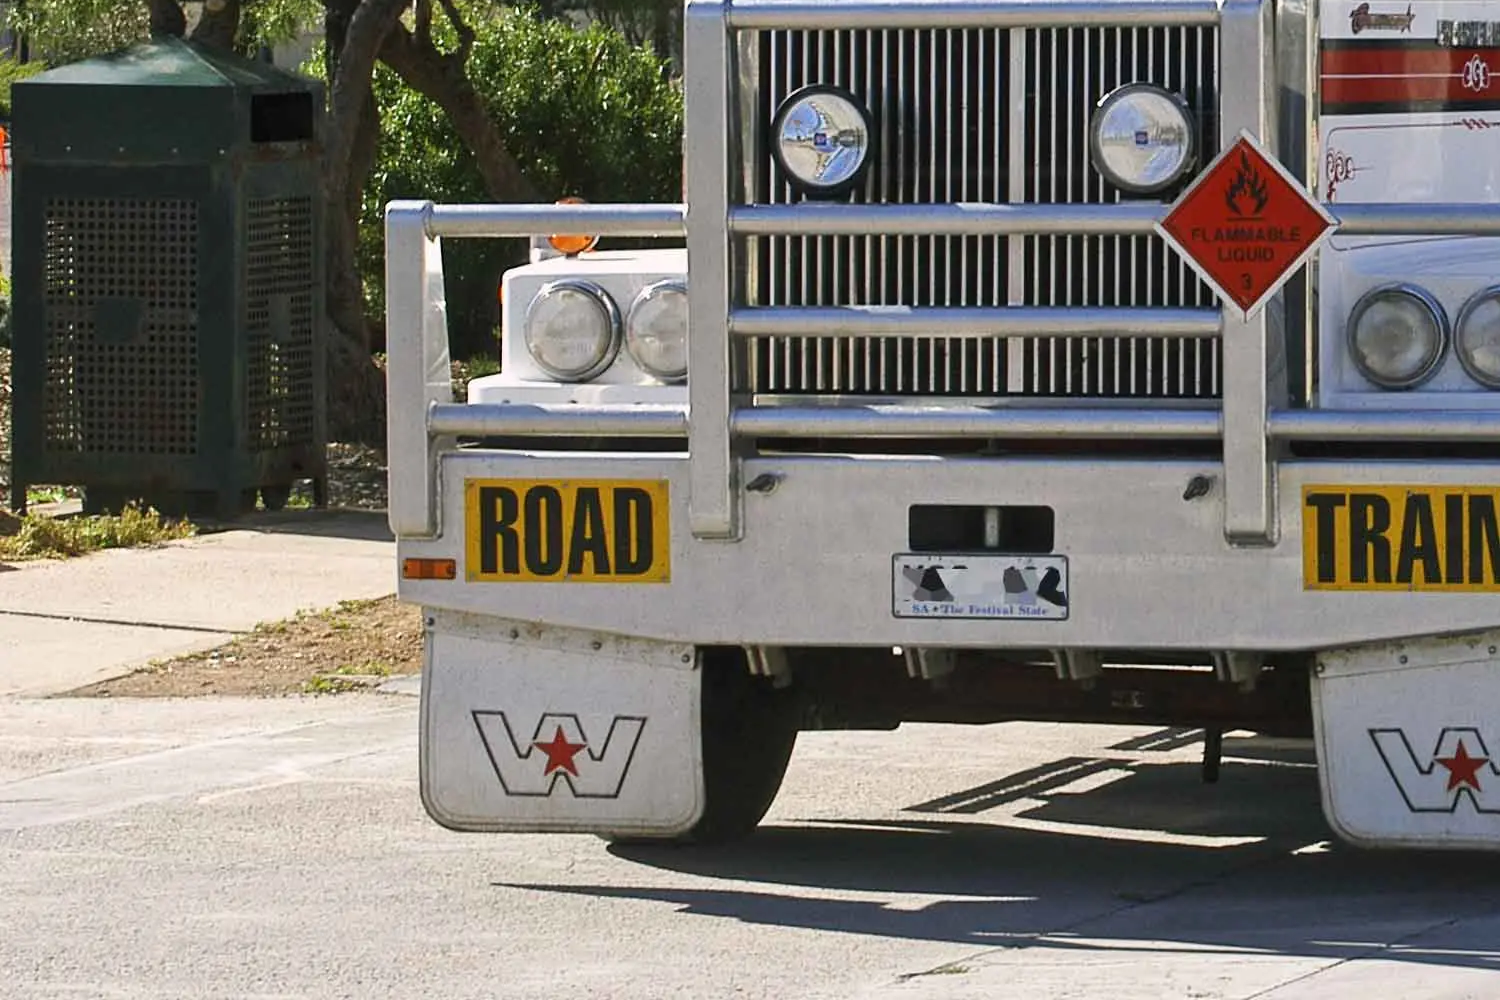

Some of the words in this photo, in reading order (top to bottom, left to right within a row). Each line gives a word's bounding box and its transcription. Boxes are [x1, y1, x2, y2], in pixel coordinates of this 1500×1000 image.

[1191, 227, 1300, 242] FLAMMABLE
[1217, 247, 1275, 263] LIQUID
[1241, 273, 1253, 290] 3
[478, 485, 654, 574] ROAD
[940, 604, 964, 614] The
[968, 604, 1014, 615] Festival
[1018, 604, 1049, 616] State
